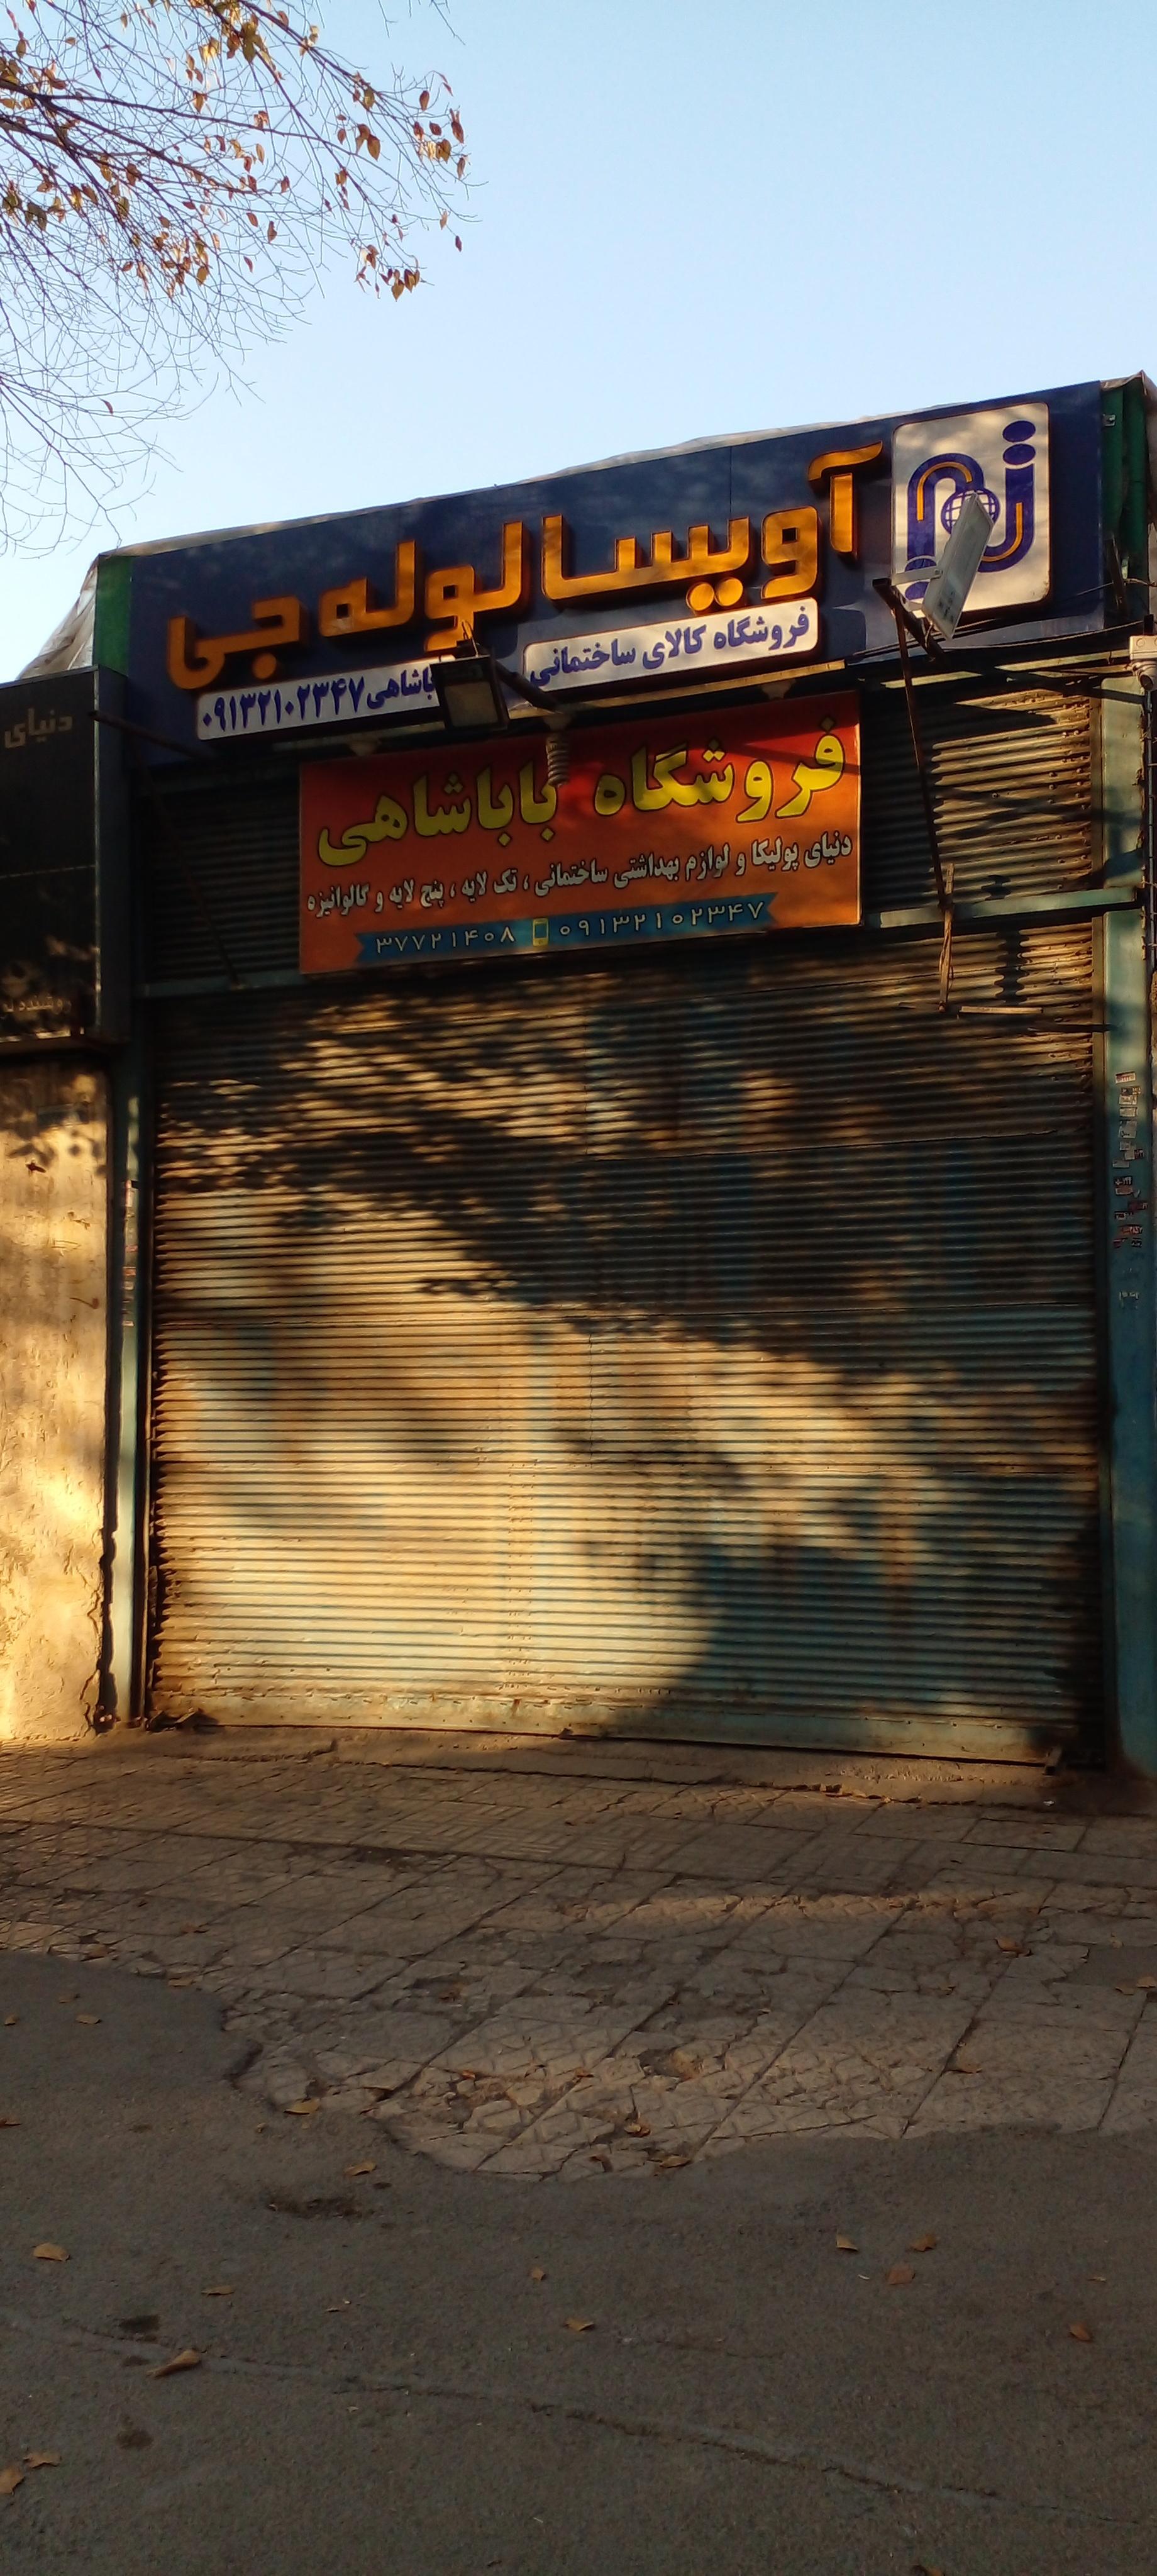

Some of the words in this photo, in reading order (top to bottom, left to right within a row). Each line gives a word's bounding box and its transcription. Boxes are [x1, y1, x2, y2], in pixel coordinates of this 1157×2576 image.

[541, 440, 883, 614] آویسا
[318, 521, 526, 655] لوله
[167, 595, 304, 690] جی
[643, 625, 707, 670] کالای
[713, 606, 810, 650] فروشگاه
[530, 638, 636, 686] ساختمانی
[202, 676, 365, 732] ۰۹۱۳۲۱۰۲۳۴۷
[366, 666, 436, 709] باشاهی
[4, 708, 72, 748] دنیای
[594, 716, 845, 823] فروشگاه
[686, 843, 730, 880] لوازم
[736, 852, 747, 876] و
[751, 836, 799, 872] پولیکا
[804, 830, 853, 869] دنیای
[461, 871, 487, 904] لایه
[493, 868, 518, 894] تک
[534, 858, 609, 897] ساختمانی
[614, 853, 680, 889] بهداشتی
[375, 891, 384, 913] و
[389, 879, 414, 909] لایه
[420, 880, 444, 909] پنج
